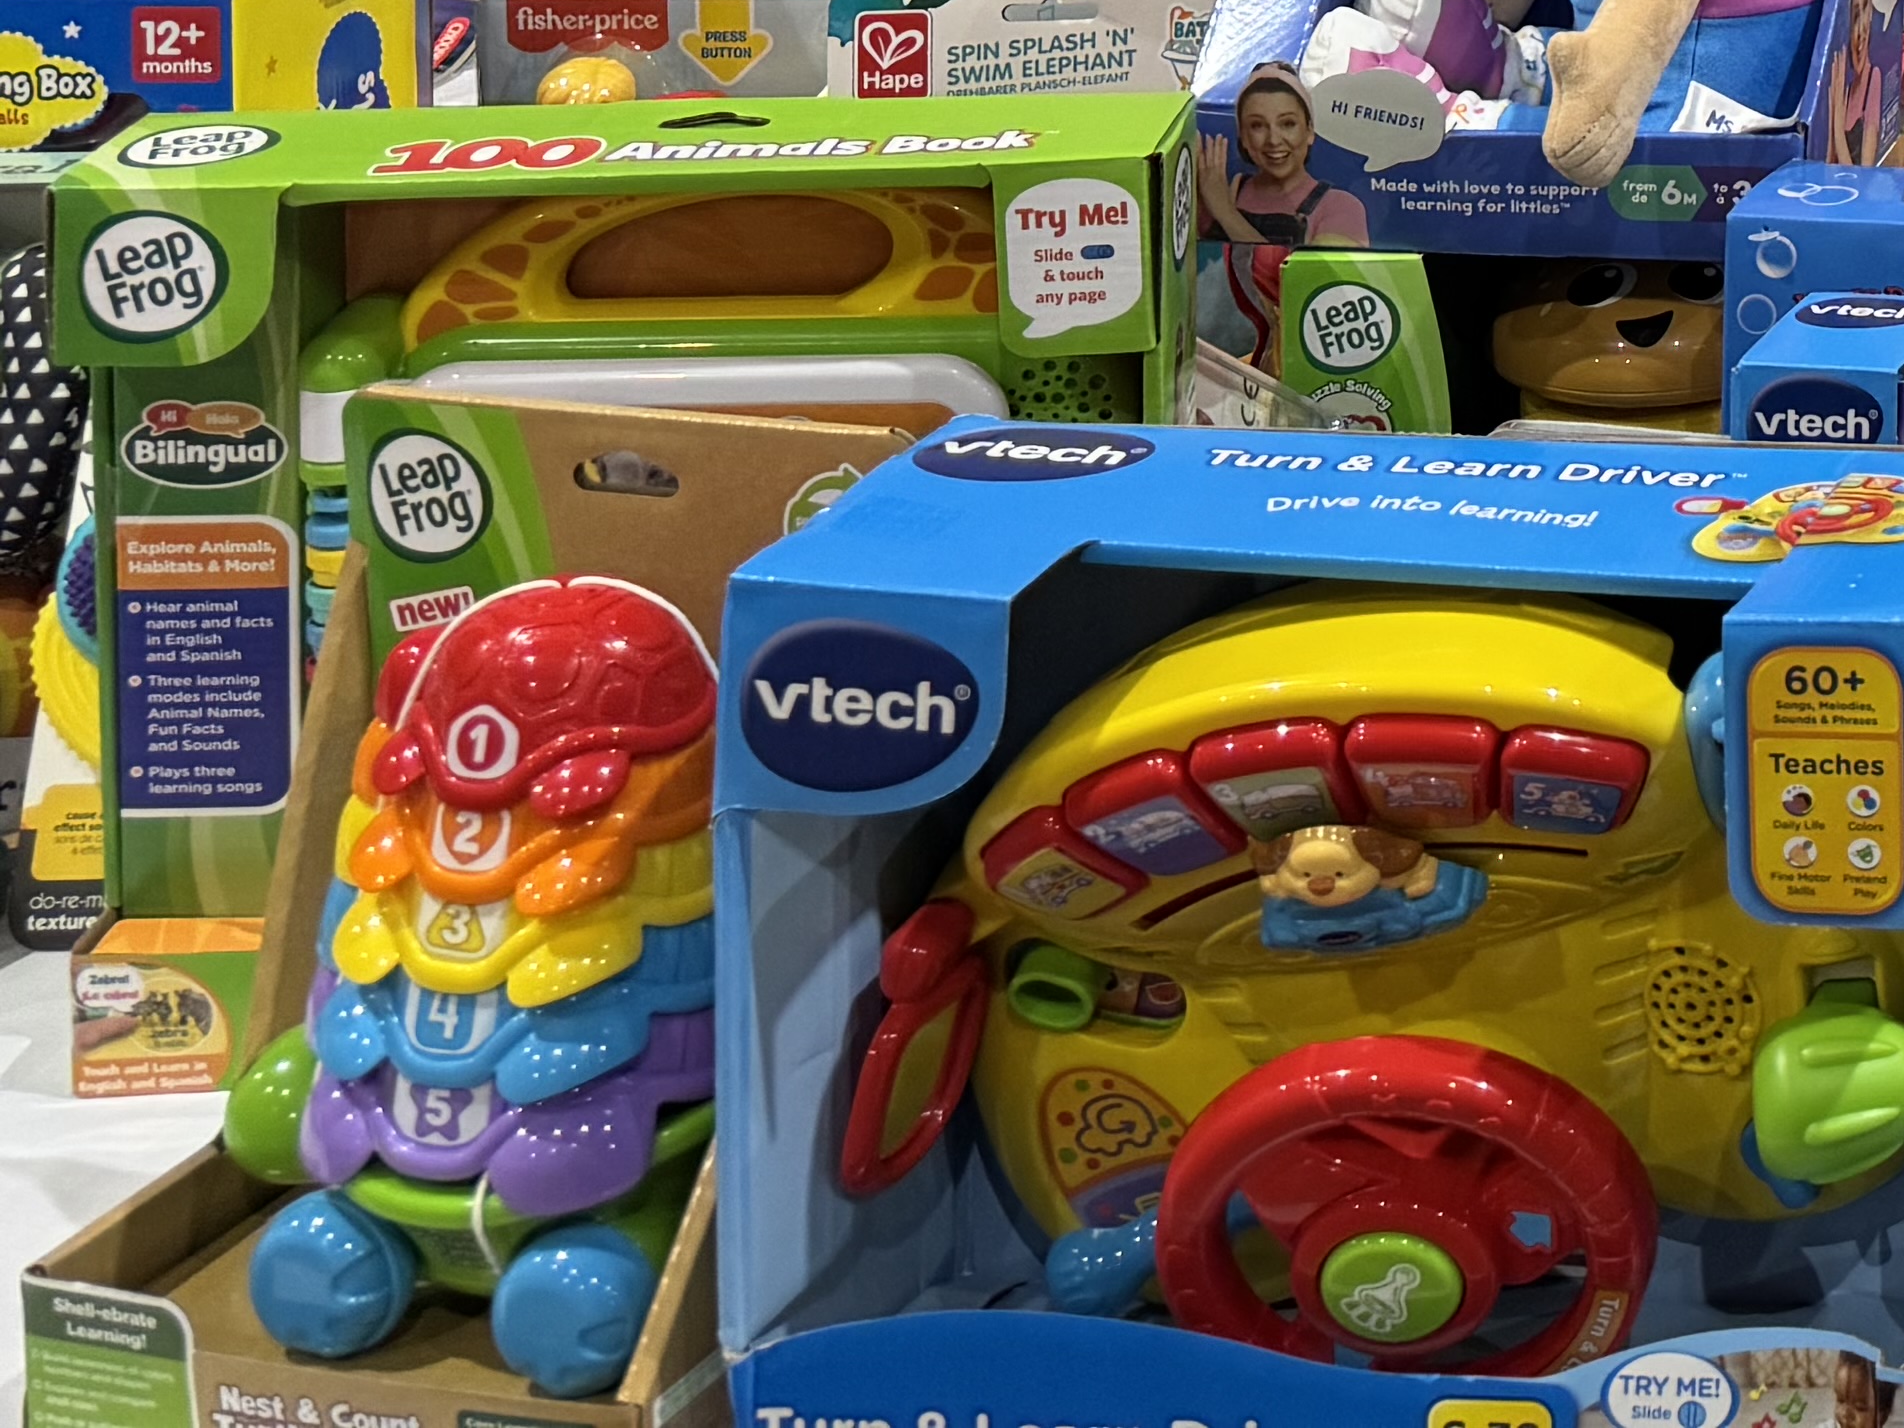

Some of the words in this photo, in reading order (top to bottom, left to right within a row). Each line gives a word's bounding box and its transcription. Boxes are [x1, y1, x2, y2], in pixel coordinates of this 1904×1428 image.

[516, 8, 658, 34] fisher-price
[140, 19, 205, 57] 12+
[704, 31, 747, 45] PRESS
[142, 58, 213, 75] months
[1331, 99, 1351, 116] HI
[1353, 101, 1425, 131] FRIENDS!
[1370, 177, 1416, 193] Made
[1423, 178, 1458, 194] with
[1464, 181, 1500, 196] love
[1507, 181, 1525, 196] to
[1530, 182, 1599, 204] support
[1015, 205, 1066, 237] Try
[1079, 203, 1128, 226] Me!
[95, 230, 194, 282] Leap
[1034, 247, 1073, 264] Slide
[1035, 288, 1062, 306] any
[1067, 287, 1107, 307] page
[1310, 294, 1377, 332] Leap
[1319, 319, 1384, 359] Frog
[1755, 408, 1872, 440] vtech
[134, 436, 277, 470] Bilingual
[1208, 447, 1325, 472] Turn
[1338, 452, 1374, 473] &
[1390, 455, 1542, 481] Learn
[1558, 462, 1727, 489] Driver
[378, 451, 460, 498] Leap
[391, 491, 474, 537] Frog
[146, 649, 175, 663] and
[180, 648, 242, 665] Spanish
[147, 673, 191, 688] Three
[196, 672, 260, 691] learning
[1785, 664, 1866, 696] 60+
[755, 678, 956, 734] vtech
[471, 721, 488, 762] 1
[1769, 753, 1884, 777] Teaches
[149, 780, 211, 798] learning
[216, 781, 263, 797] songs
[1519, 783, 1543, 804] 5
[427, 993, 458, 1040] 4
[427, 1089, 452, 1124] 5
[1591, 1297, 1621, 1334] Turn
[66, 1321, 148, 1349] Learning!
[1618, 1375, 1670, 1399] TRY
[1674, 1377, 1722, 1400] ME!
[220, 1386, 284, 1421] Nest
[297, 1396, 320, 1423] &
[1631, 1403, 1672, 1421] Slide
